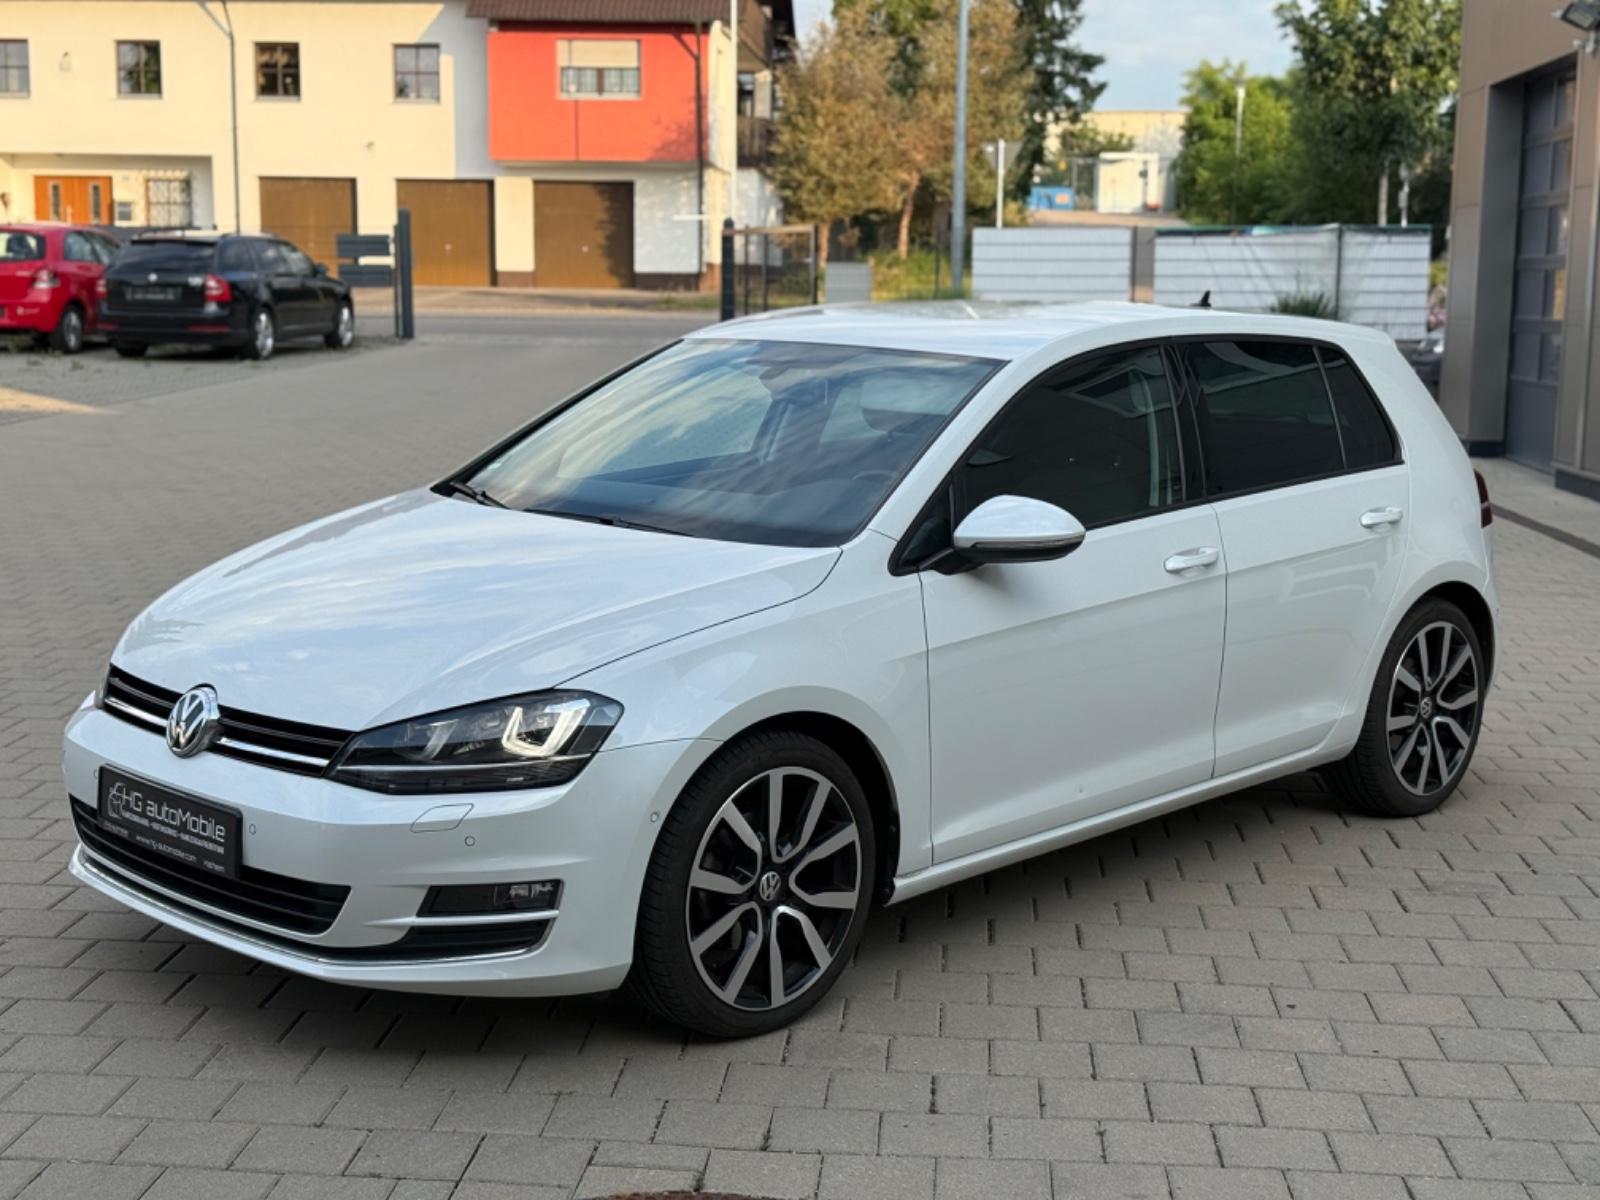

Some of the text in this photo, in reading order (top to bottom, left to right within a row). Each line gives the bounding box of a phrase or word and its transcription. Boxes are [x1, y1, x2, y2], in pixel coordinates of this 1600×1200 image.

[166, 686, 213, 757] VW
[146, 799, 225, 843] autoMobile
[759, 870, 781, 901] VW
